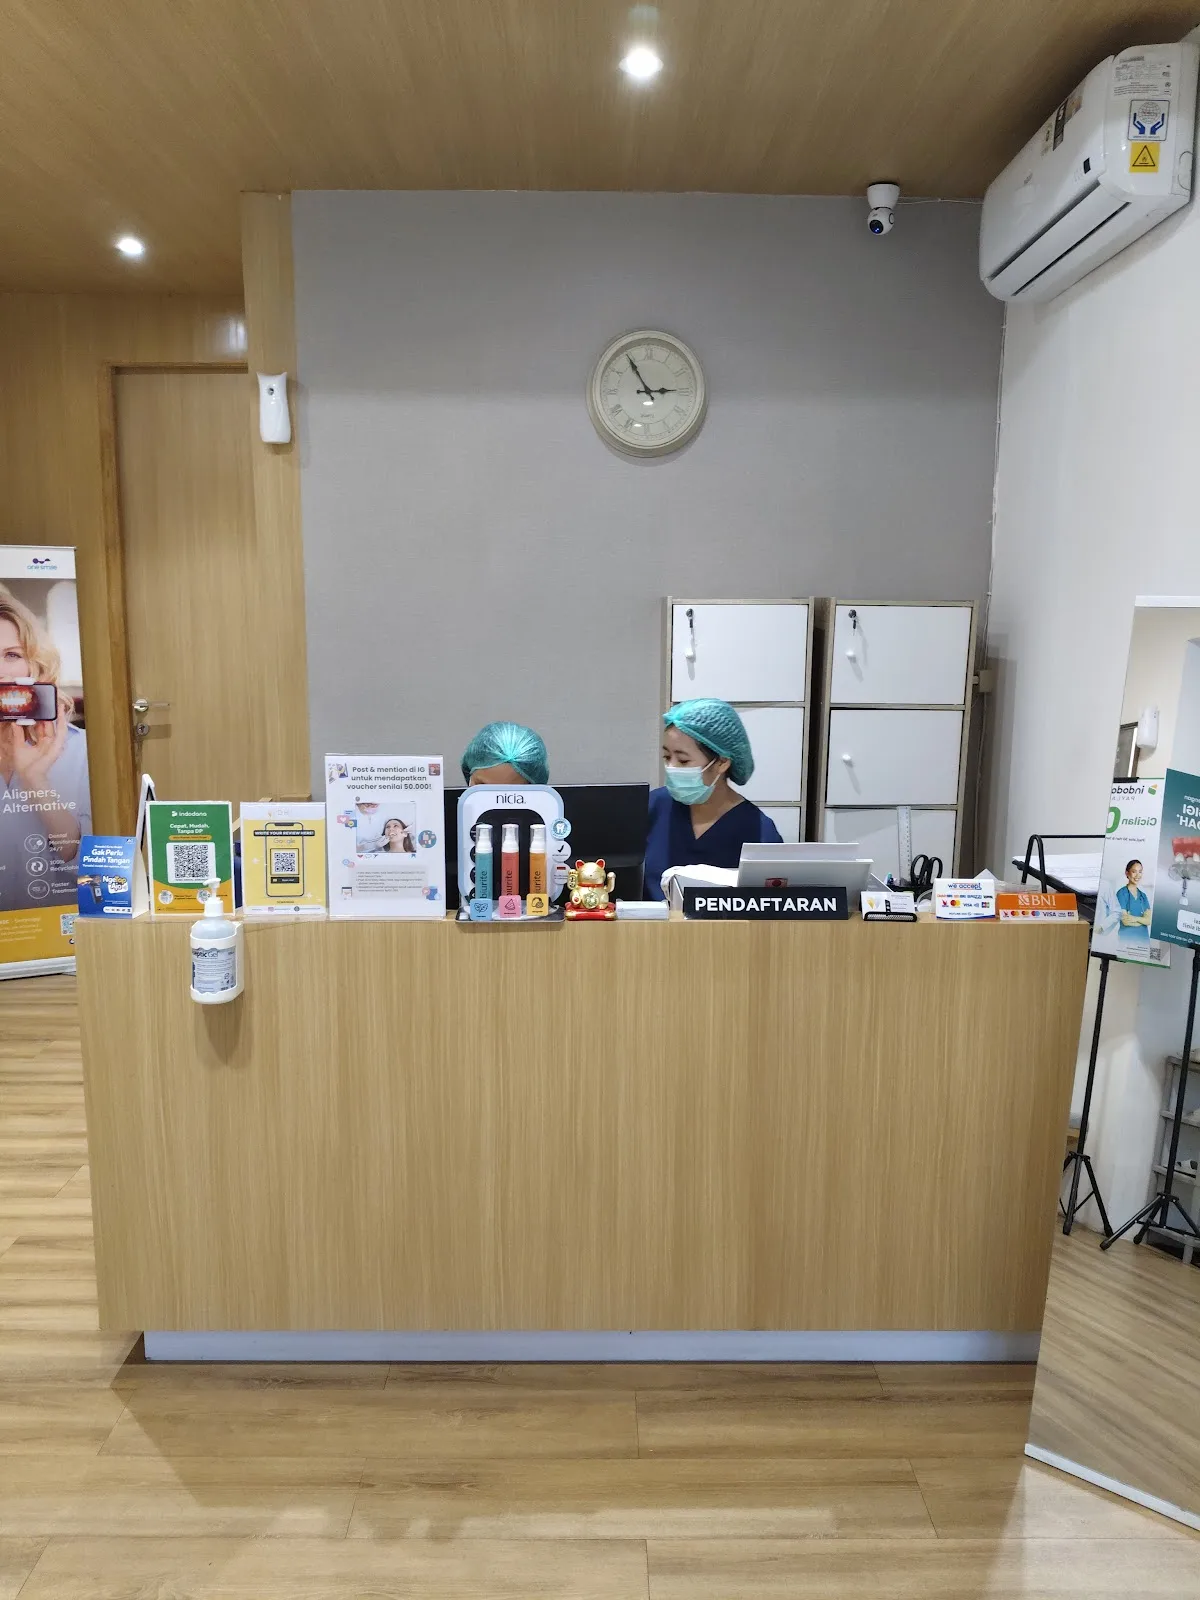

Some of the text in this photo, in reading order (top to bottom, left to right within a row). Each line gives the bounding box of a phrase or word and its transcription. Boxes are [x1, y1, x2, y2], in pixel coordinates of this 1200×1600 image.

[374, 775, 427, 783] mendapatkan
[2, 789, 61, 802] Aligners,
[496, 793, 524, 804] nicia
[3, 802, 76, 814] Alternative
[107, 856, 130, 865] Tangan
[479, 870, 488, 899] biurite
[694, 897, 837, 912] PENDAFTARAN
[1031, 895, 1056, 906] BNI
